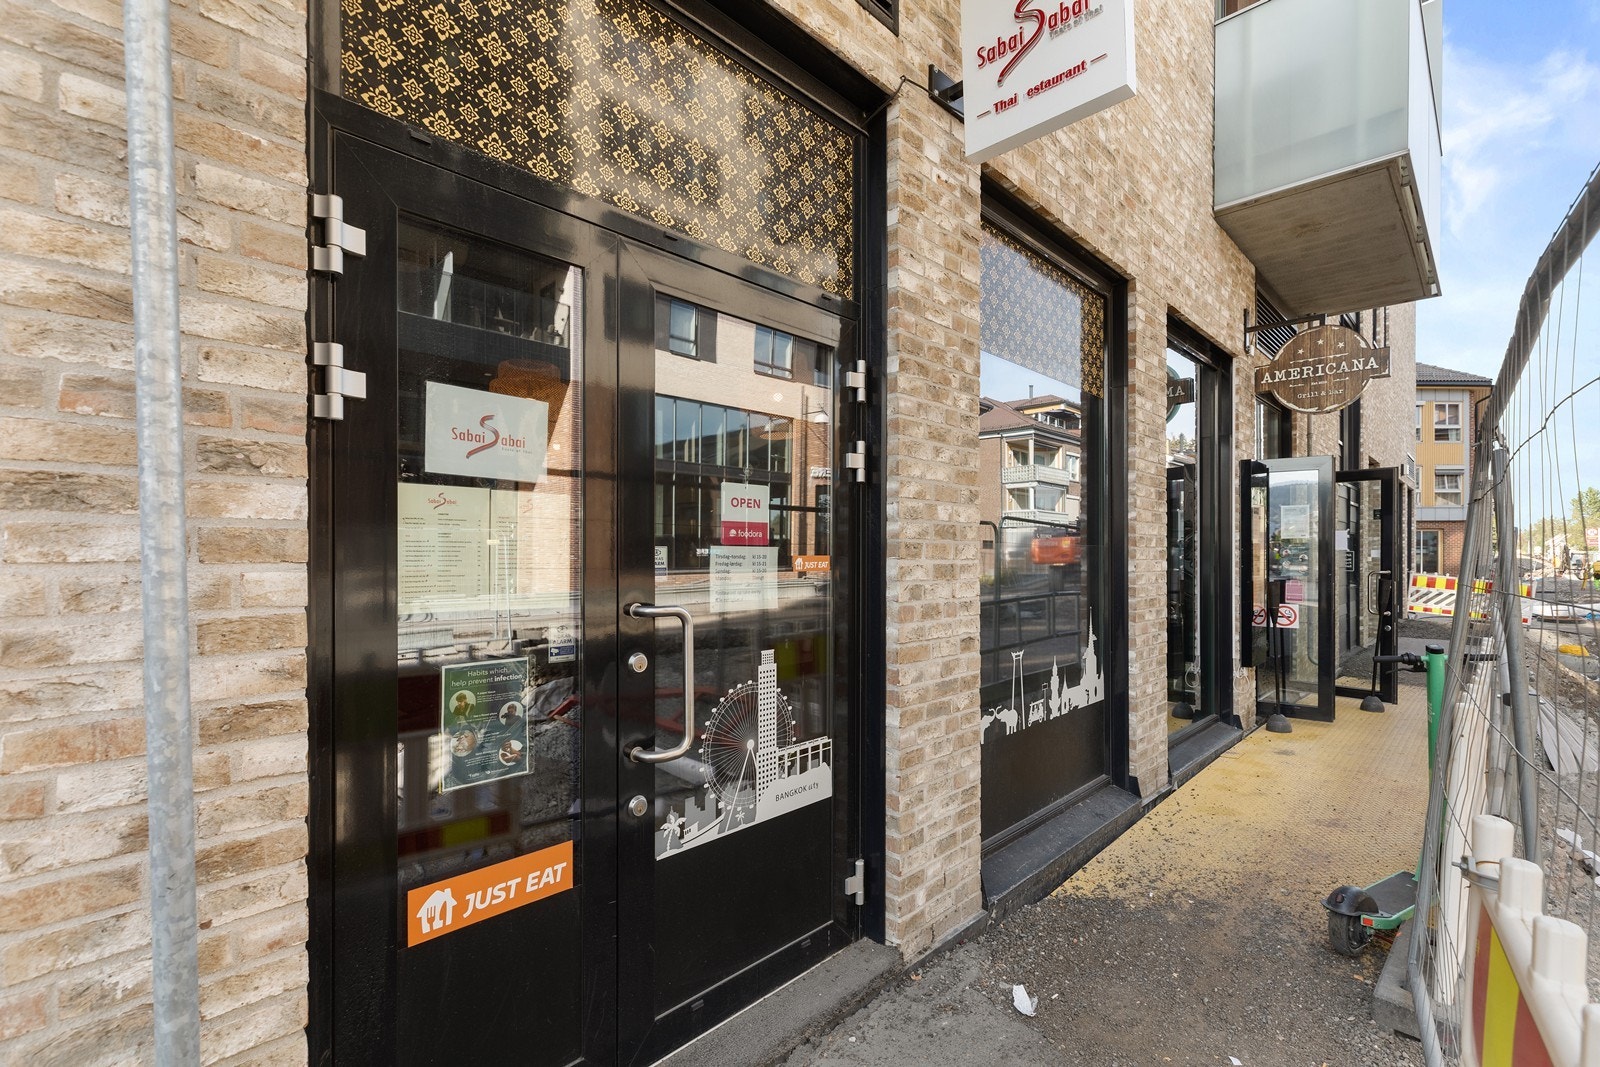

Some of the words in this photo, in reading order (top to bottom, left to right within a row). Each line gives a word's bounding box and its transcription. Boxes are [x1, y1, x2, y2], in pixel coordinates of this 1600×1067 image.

[977, 26, 1025, 68] Sabai
[993, 93, 1019, 115] Thai
[1261, 357, 1380, 384] AMERICANA
[1297, 391, 1319, 399] Grill
[451, 427, 486, 444] Sabai
[730, 497, 761, 509] OPEN
[738, 529, 763, 538] foodora
[804, 561, 818, 570] JUST
[818, 561, 829, 569] EAT
[467, 669, 488, 677] Habits
[490, 667, 508, 675] which
[451, 679, 467, 688] help
[468, 677, 494, 687] prevent
[494, 673, 523, 682] infection
[775, 784, 808, 802] BANGKOK
[462, 877, 522, 918] JUST
[525, 862, 567, 893] EAT
